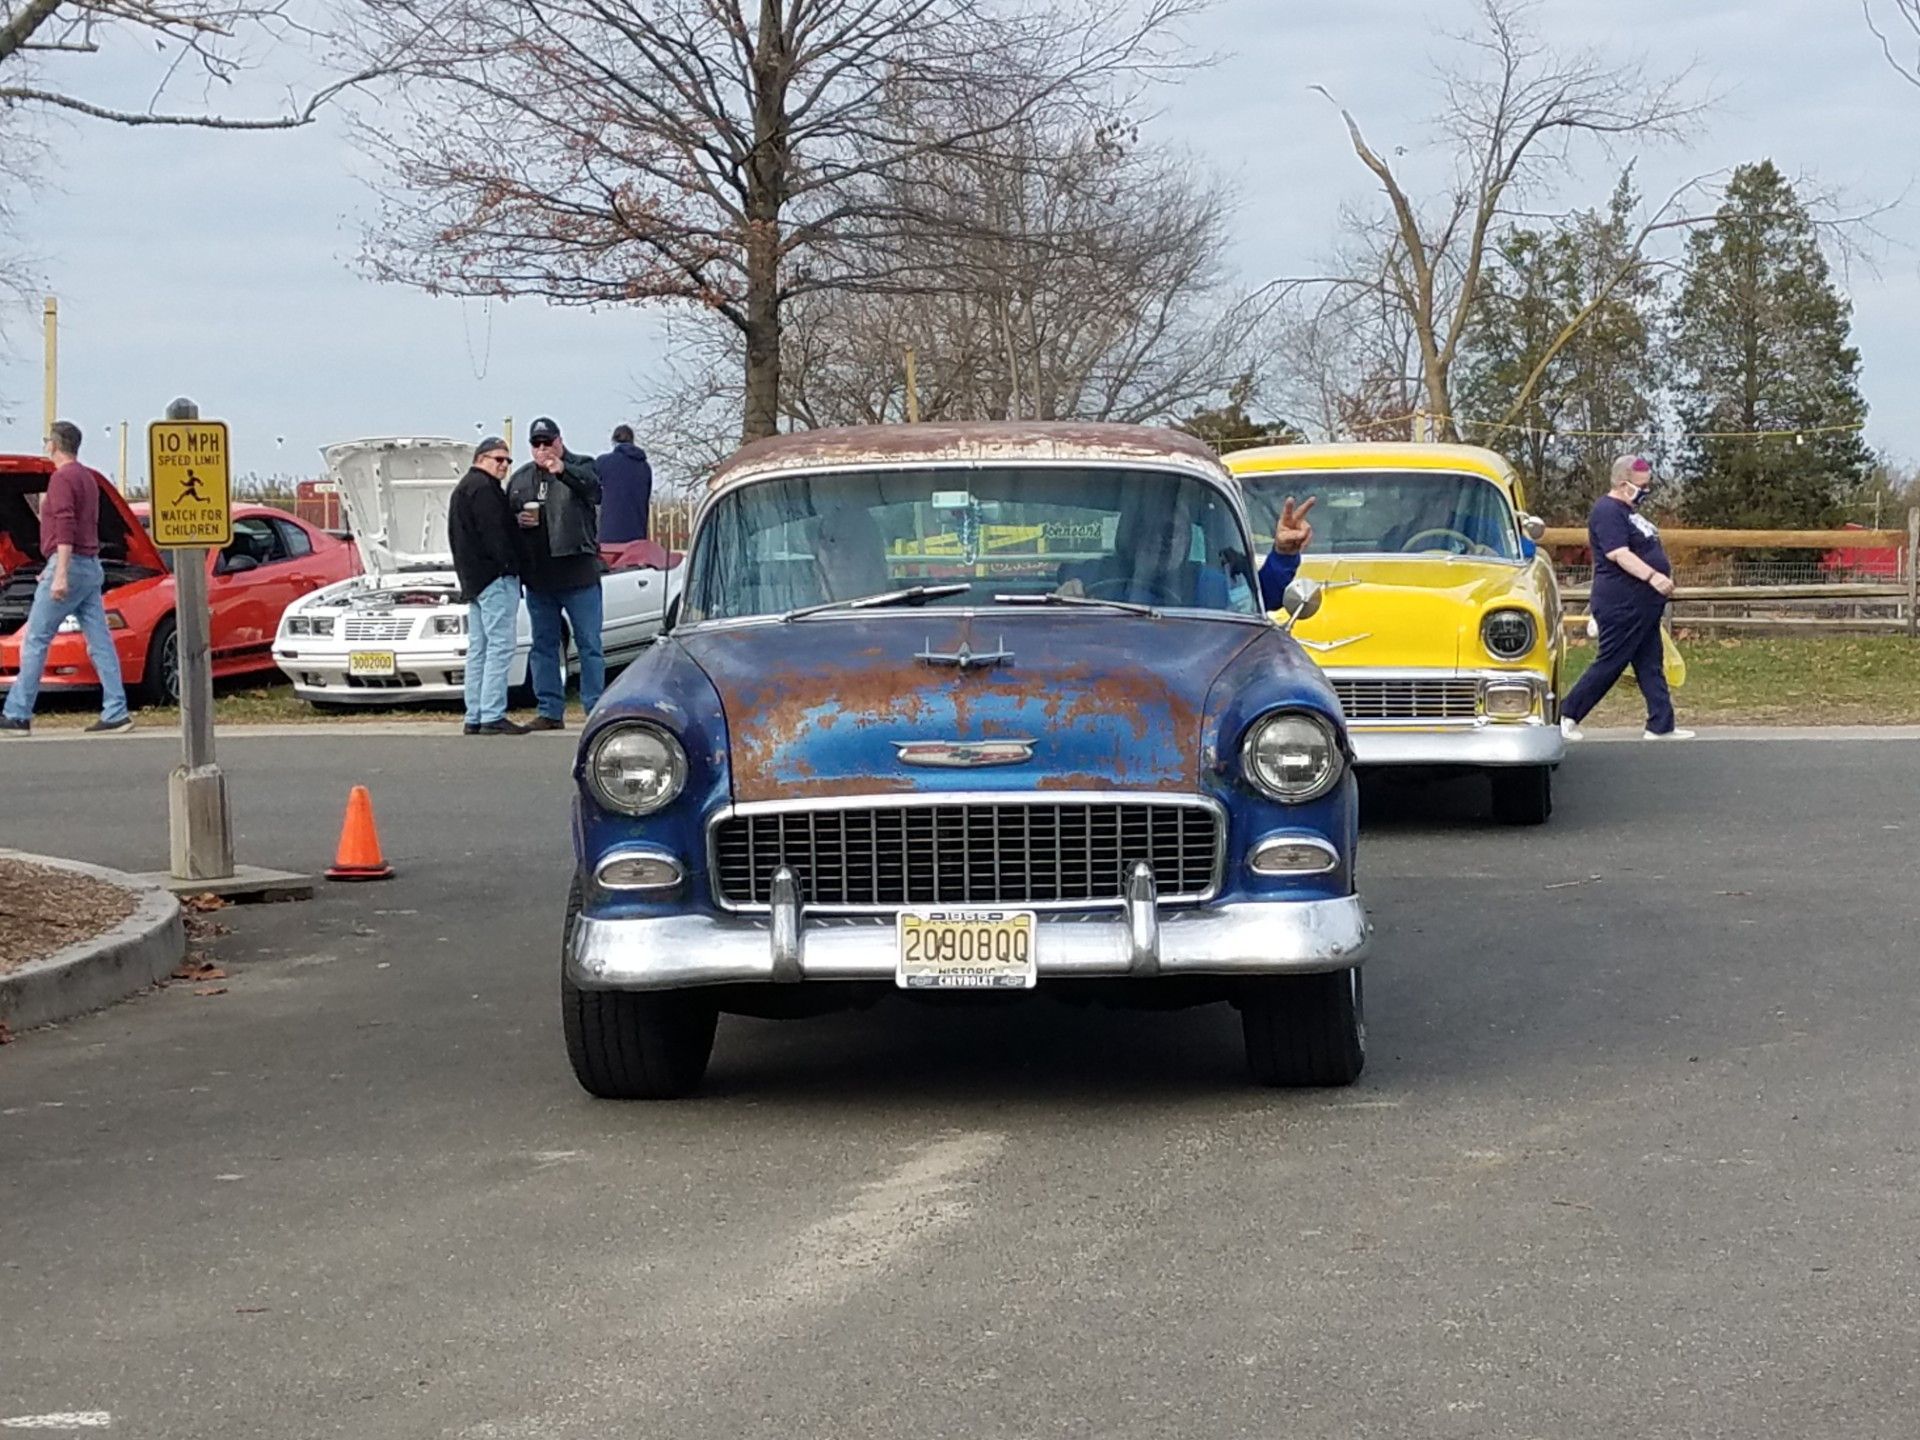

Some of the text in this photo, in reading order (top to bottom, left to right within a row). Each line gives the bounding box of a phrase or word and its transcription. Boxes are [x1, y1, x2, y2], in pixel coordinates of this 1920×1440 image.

[158, 432, 219, 453] 10 MPH
[158, 454, 221, 466] SPEED LIMIT
[161, 509, 223, 521] WATCH FOR
[164, 524, 219, 536] CHILDREN
[906, 929, 1028, 963] 20908QQ
[938, 975, 995, 986] CHEVROLET
